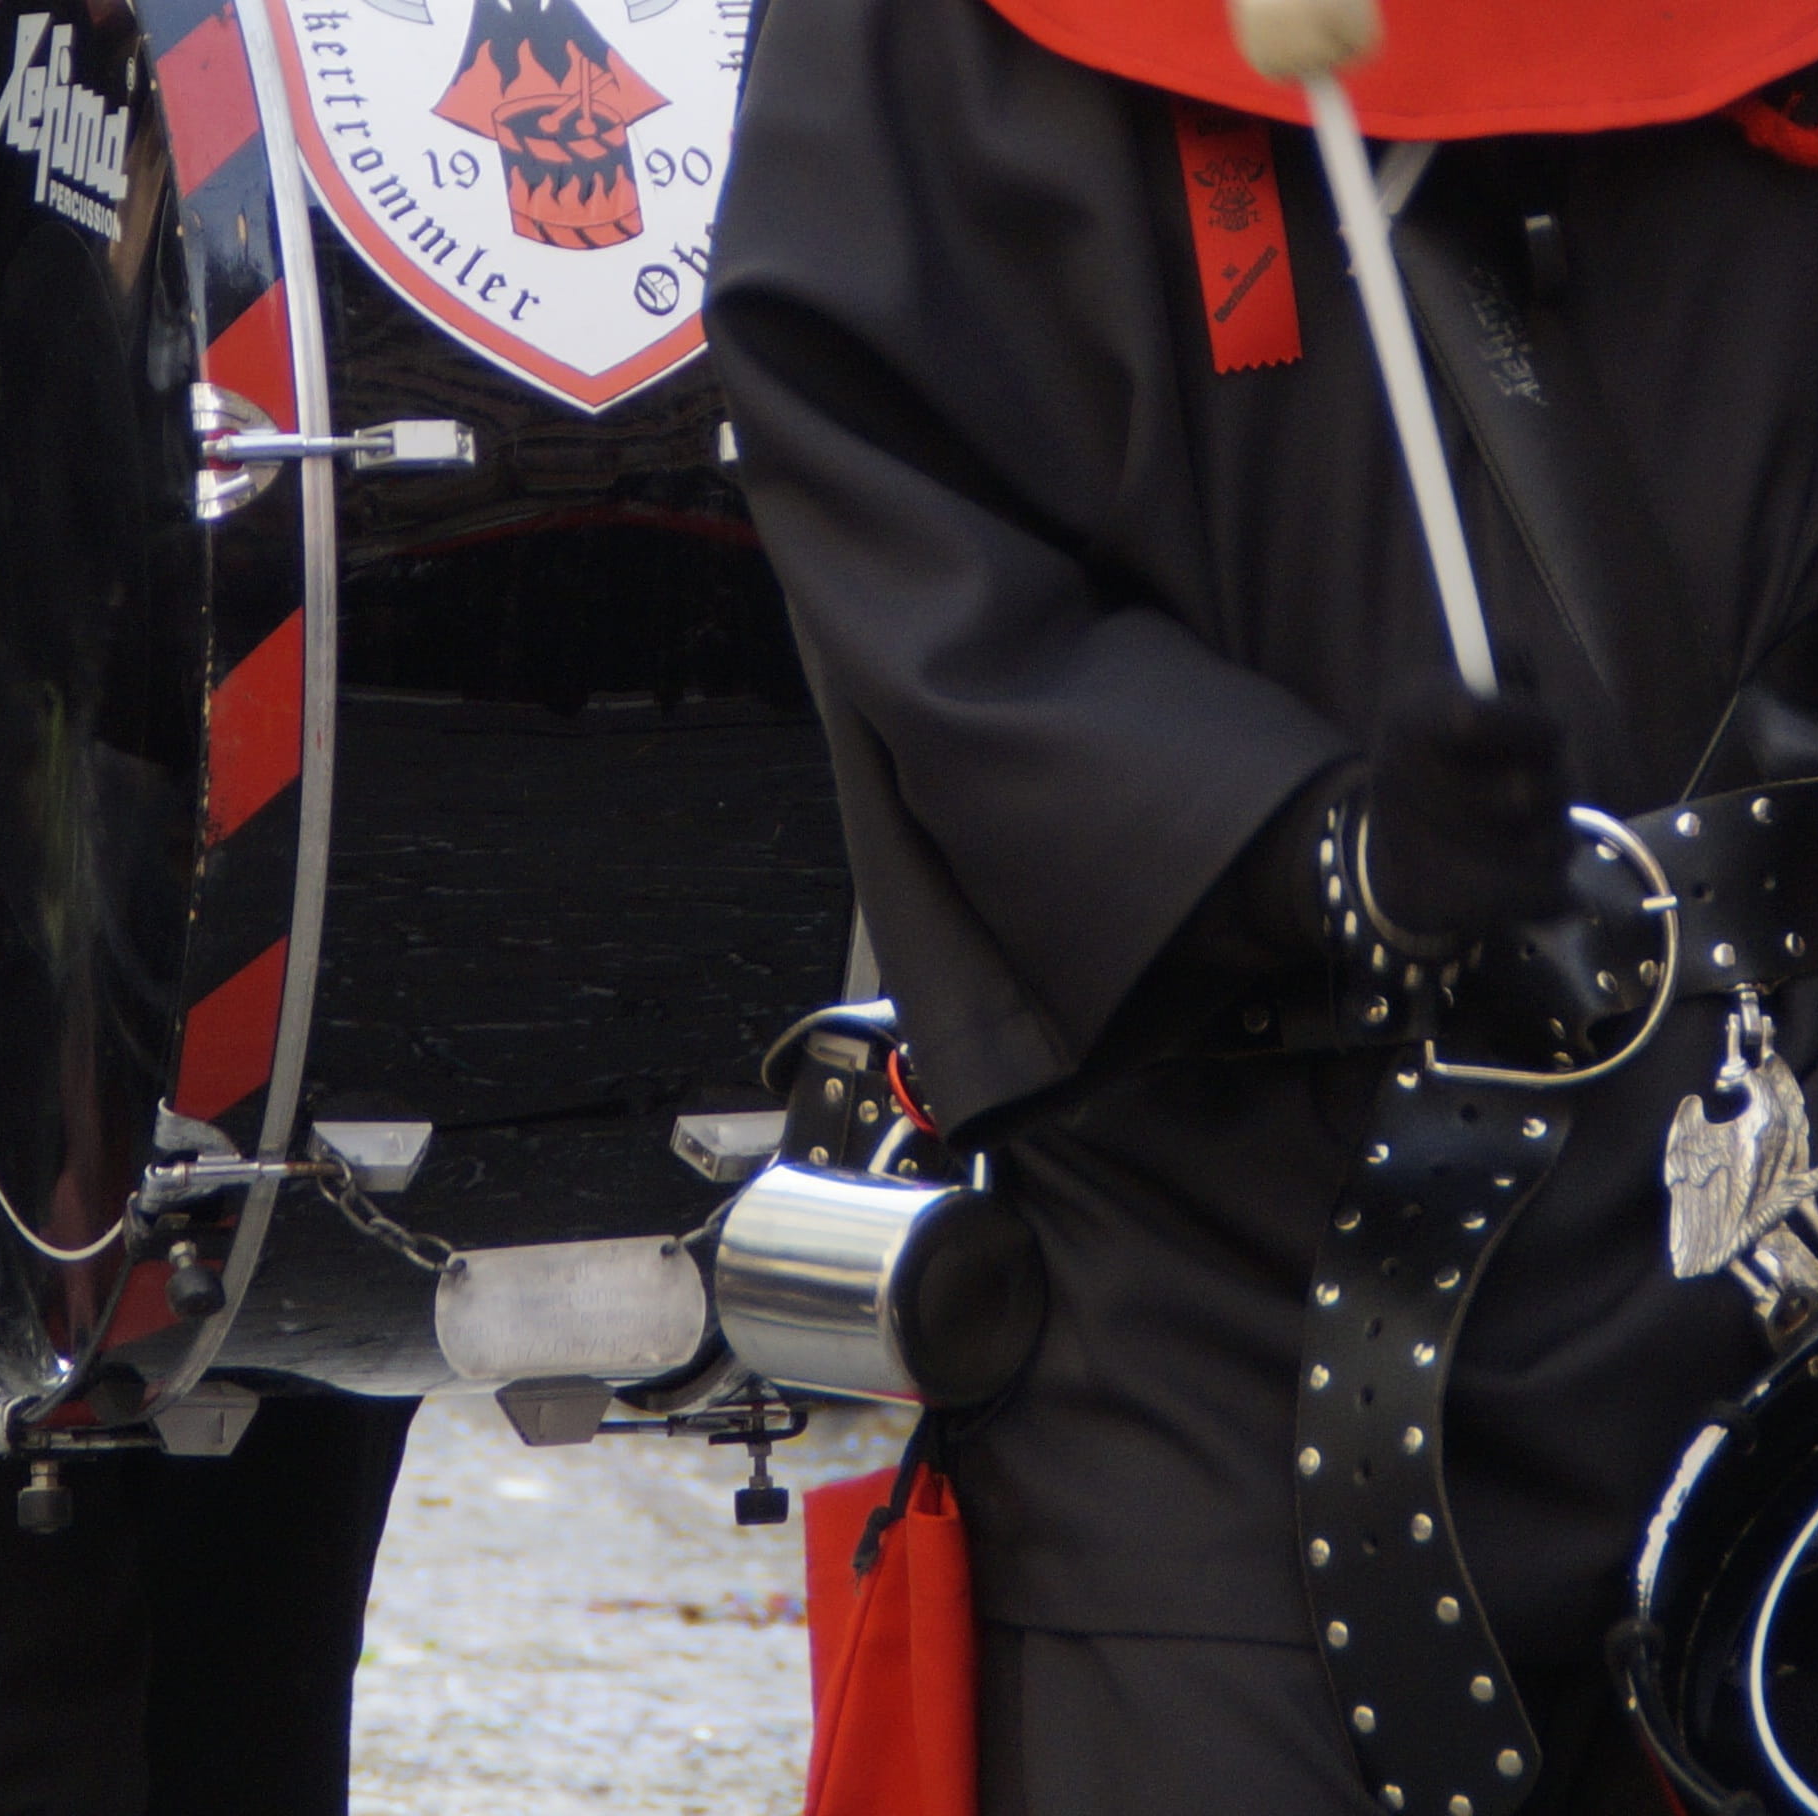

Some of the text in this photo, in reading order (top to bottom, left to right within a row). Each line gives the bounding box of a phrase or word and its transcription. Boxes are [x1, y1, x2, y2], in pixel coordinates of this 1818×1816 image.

[423, 145, 713, 190] 19 90
[48, 179, 122, 243] PERCUSSION
